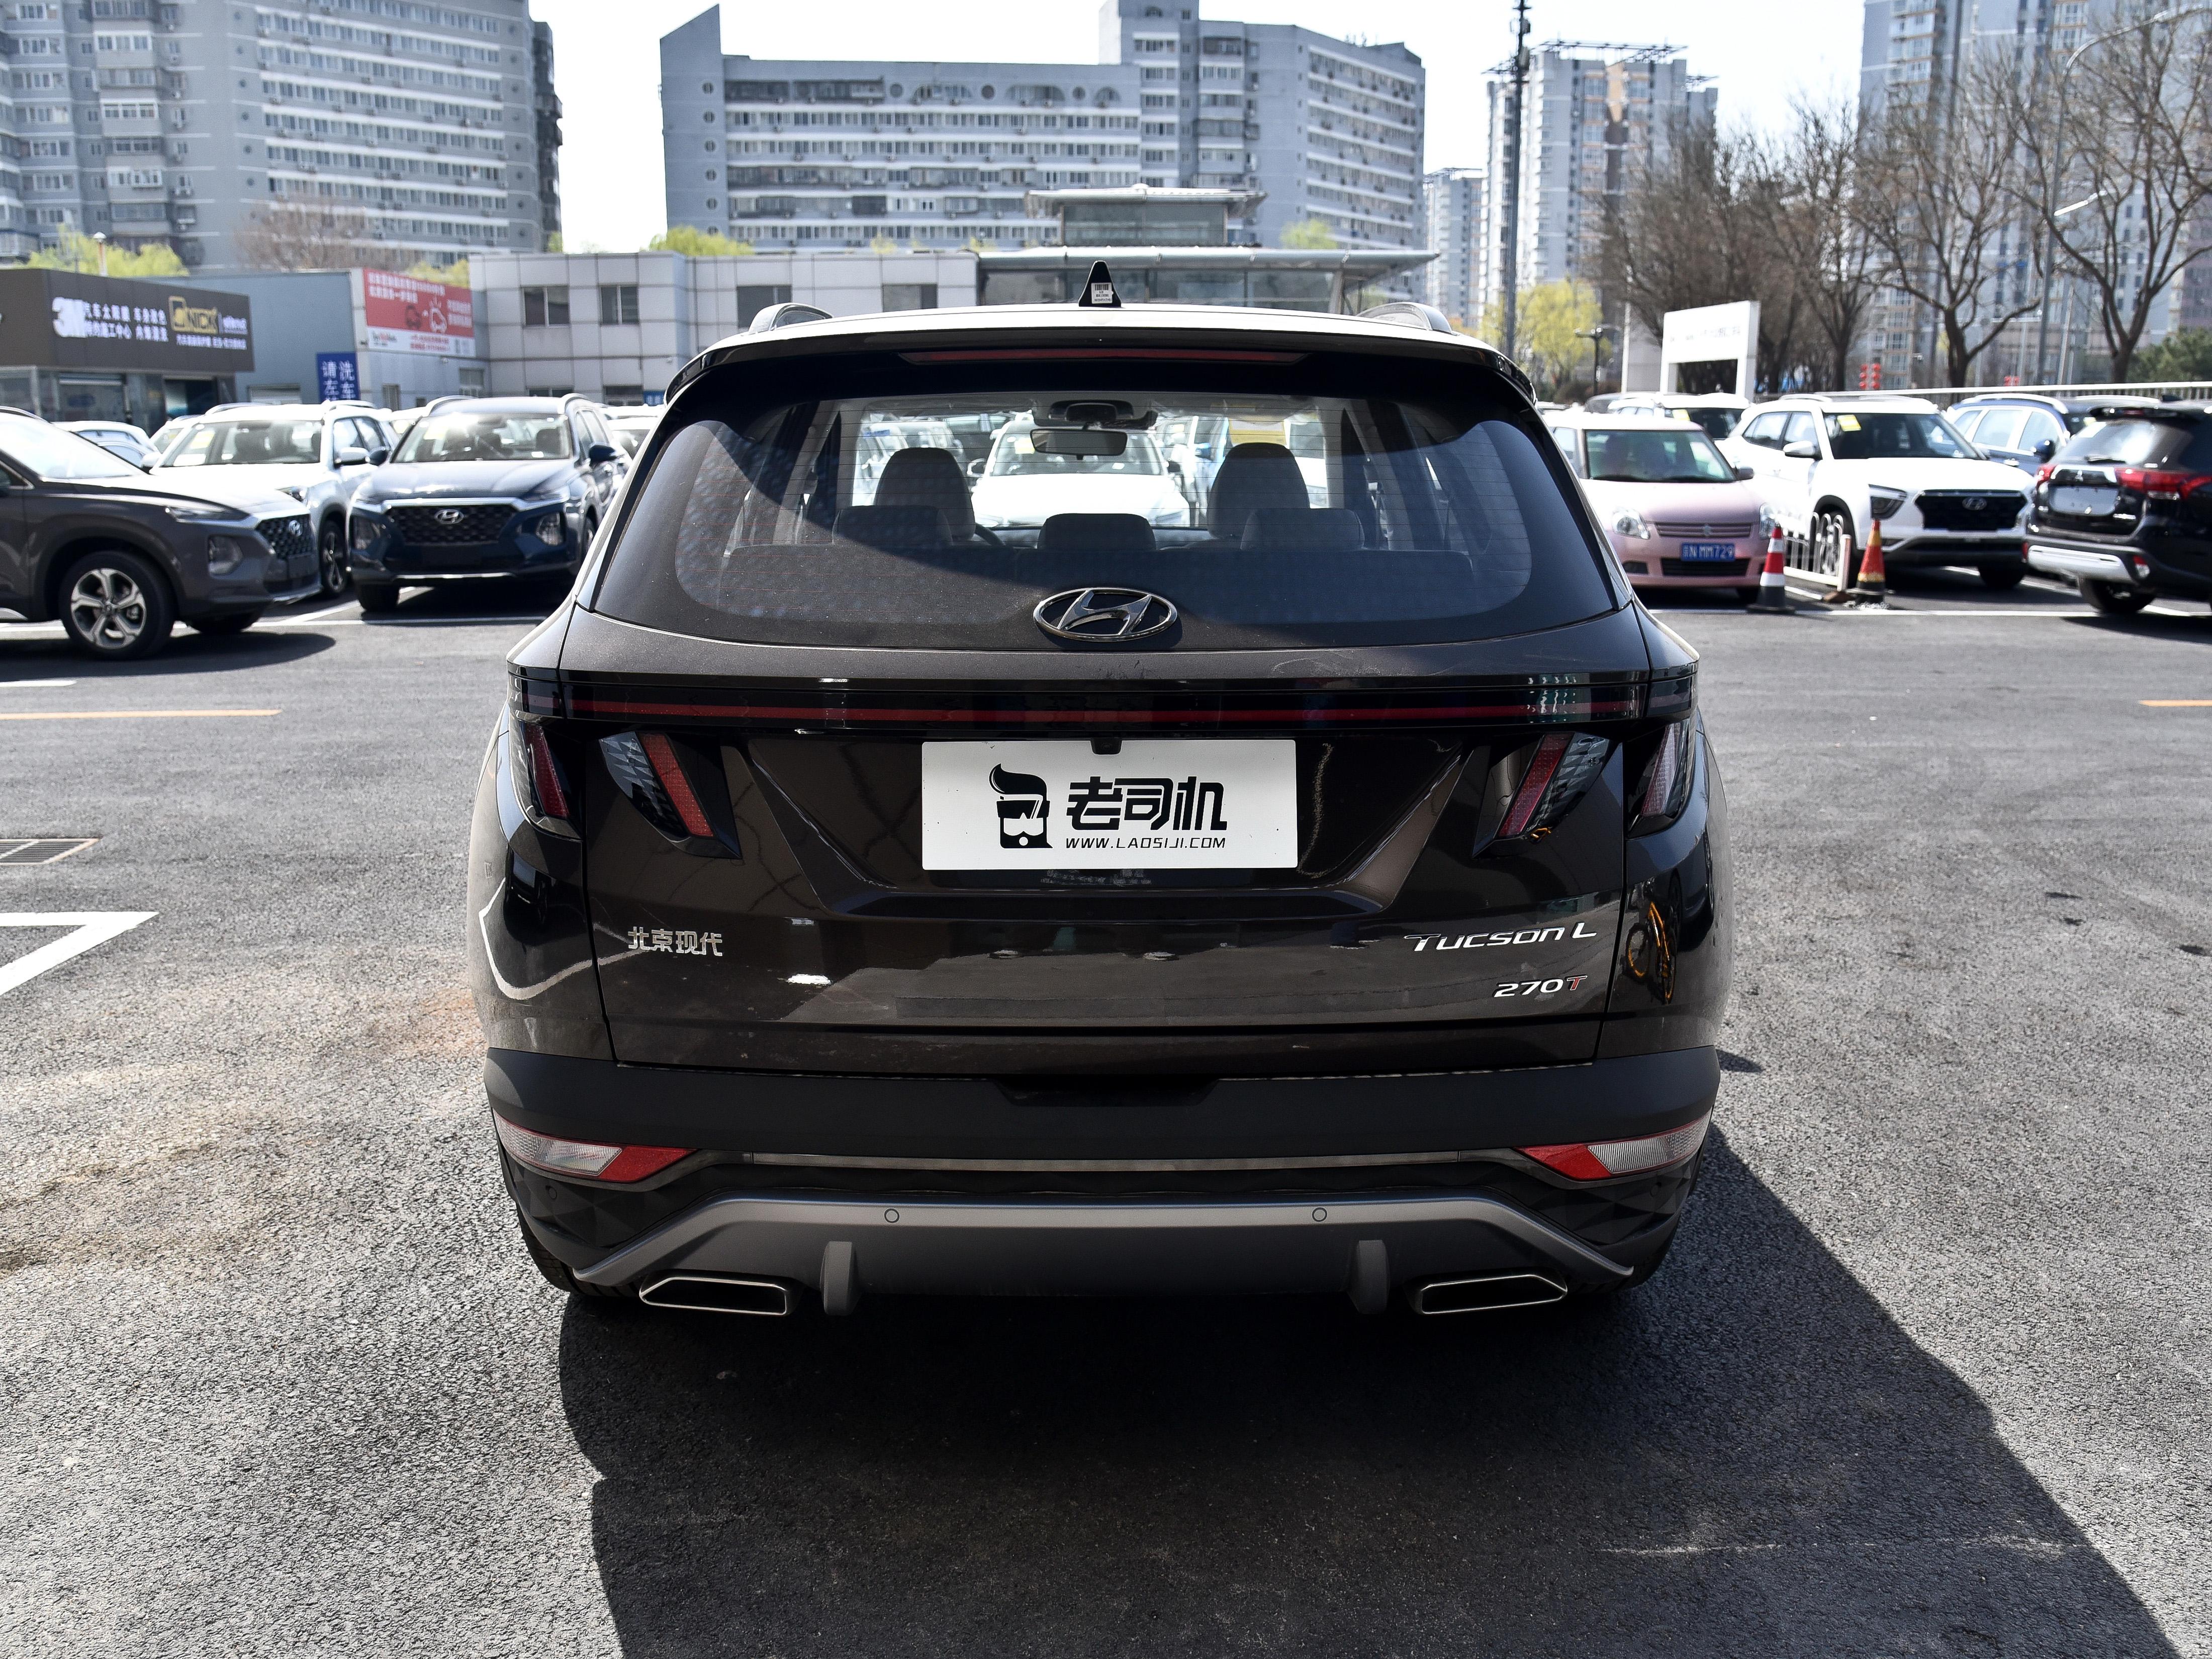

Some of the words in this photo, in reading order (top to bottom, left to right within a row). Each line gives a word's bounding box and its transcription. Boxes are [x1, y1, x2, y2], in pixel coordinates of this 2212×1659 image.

[338, 360, 356, 399] 洗车
[1066, 776, 1228, 831] 老司机
[1065, 838, 1226, 849] WWW.LAOSIJI.COM
[628, 927, 722, 956] 北京现代
[1571, 922, 1597, 940] L
[1492, 975, 1588, 997] 270T
